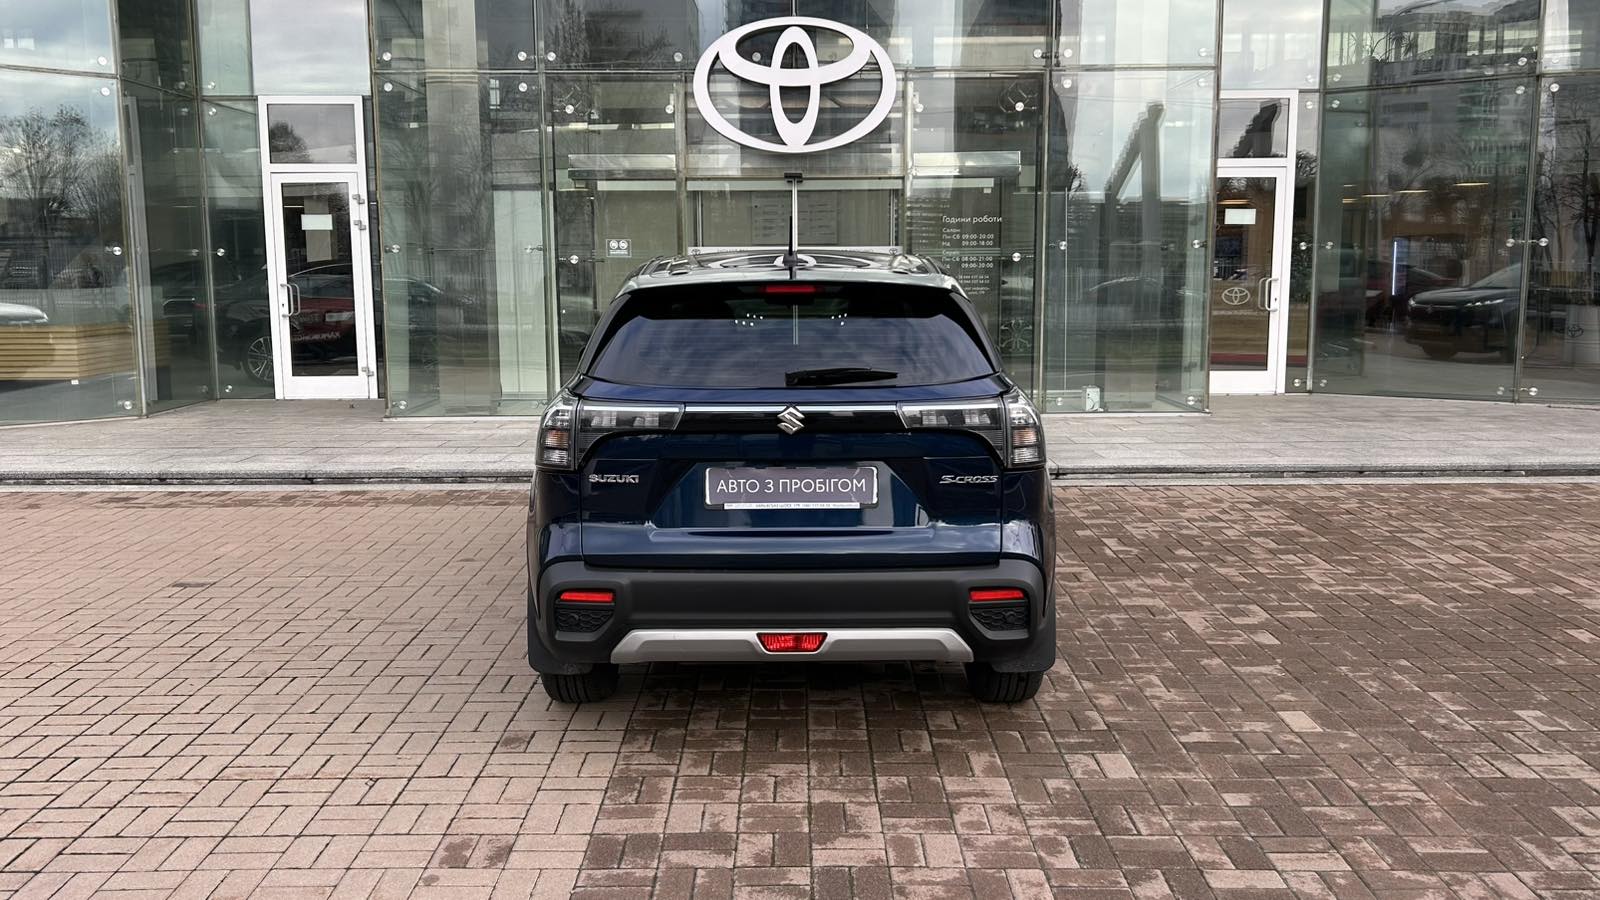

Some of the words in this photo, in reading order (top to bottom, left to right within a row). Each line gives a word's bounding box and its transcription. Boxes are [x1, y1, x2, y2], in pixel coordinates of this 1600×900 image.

[943, 215, 971, 224] Години
[973, 215, 1002, 224] роботи
[589, 474, 640, 483] SUZUKI
[716, 479, 760, 493] АВТО
[779, 478, 867, 493] ПРОБІГОМ
